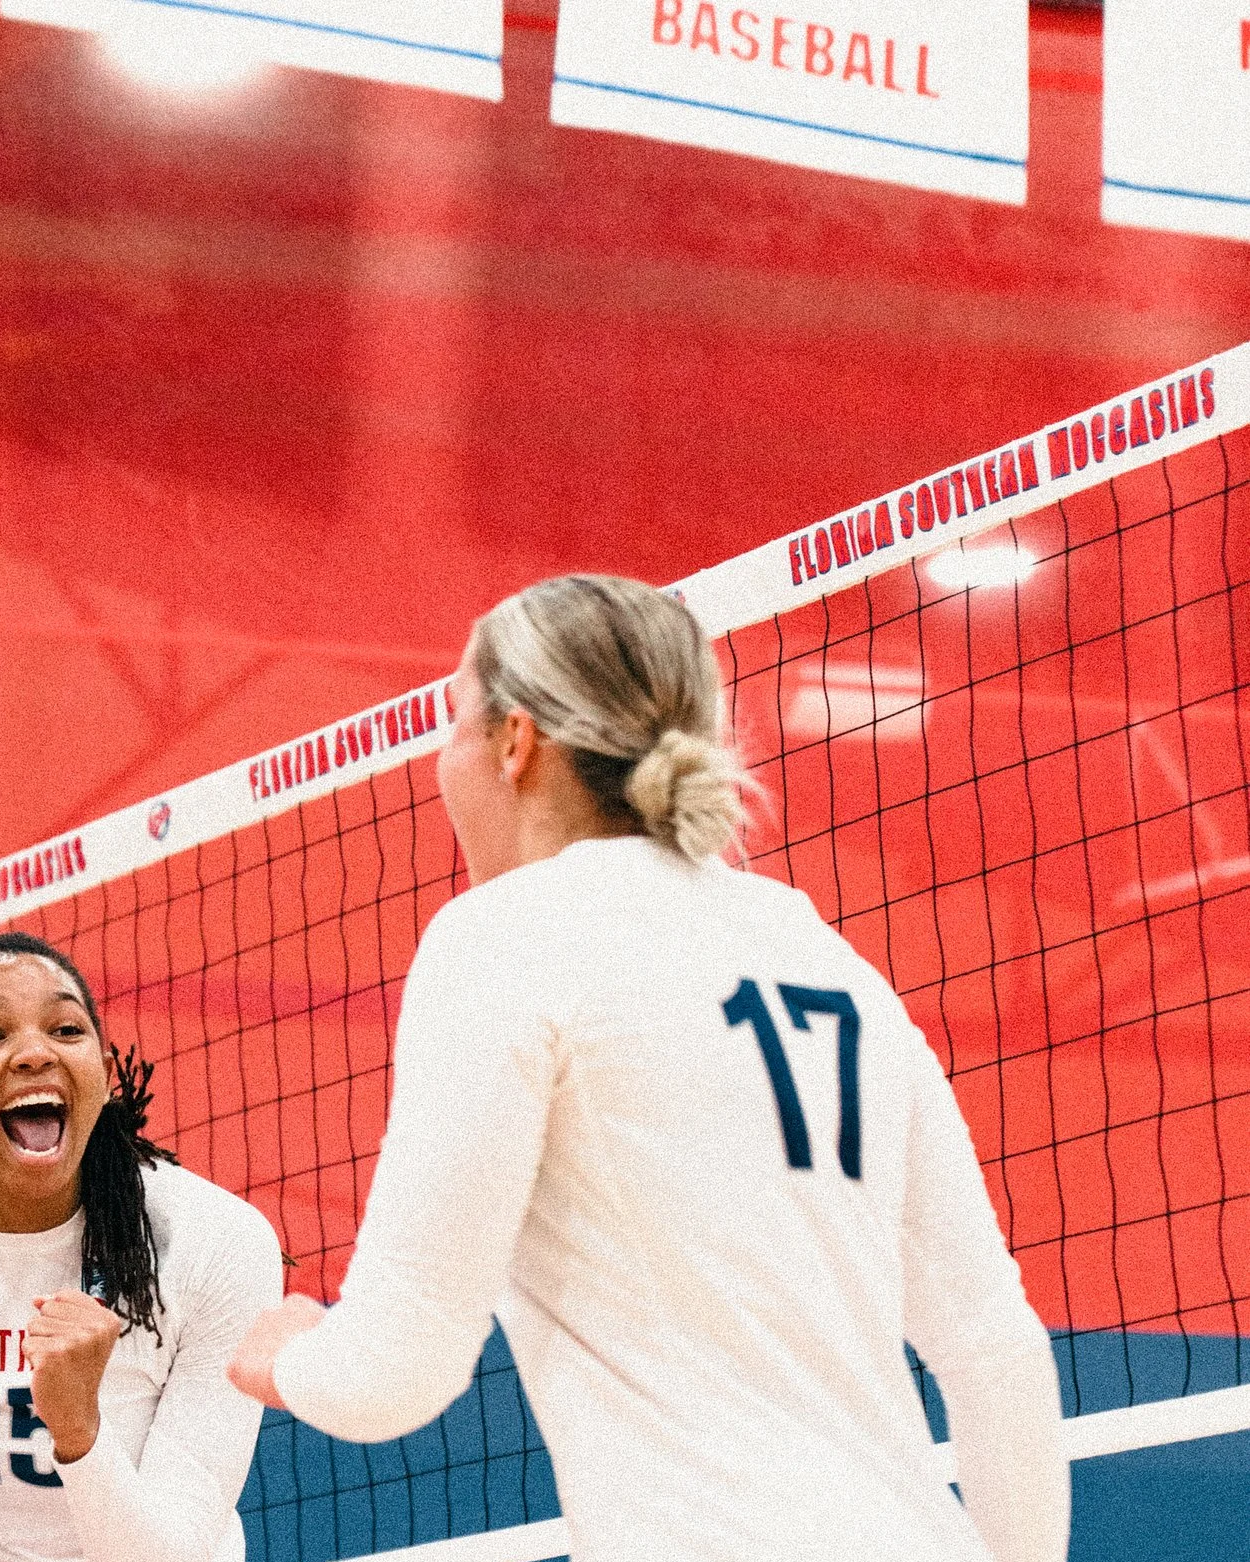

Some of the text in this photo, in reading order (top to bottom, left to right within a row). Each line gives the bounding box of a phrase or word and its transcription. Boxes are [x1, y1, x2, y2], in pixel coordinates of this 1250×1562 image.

[652, 0, 940, 99] BASEBALL
[789, 367, 1216, 587] FLORIDA SOUTHERN MOCCASINS
[721, 977, 862, 1181] 17
